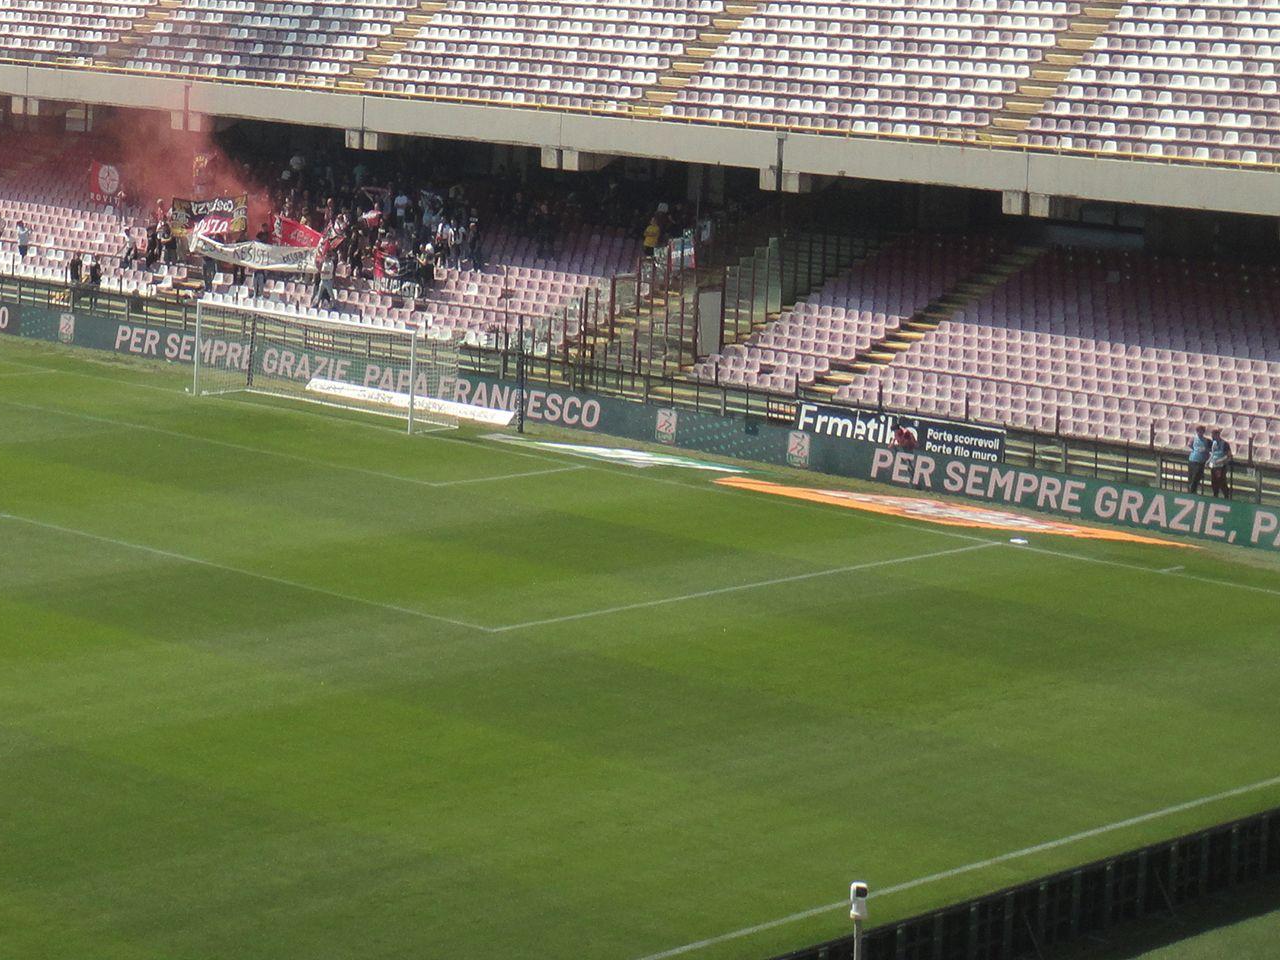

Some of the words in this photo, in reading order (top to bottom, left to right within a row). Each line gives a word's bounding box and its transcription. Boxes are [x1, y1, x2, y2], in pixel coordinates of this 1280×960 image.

[115, 325, 160, 356] PER
[164, 333, 257, 371] SEMPRE
[363, 364, 429, 396] PAPA
[436, 374, 601, 428] FRANCESCO
[925, 441, 952, 455] Porte
[954, 442, 970, 458] filo
[971, 450, 998, 462] muro
[927, 428, 953, 441] Porte
[953, 434, 1000, 450] scorrevoli
[870, 448, 936, 488] PER
[943, 460, 1086, 514] SEMPRE
[1094, 486, 1237, 544] GRAZIE,
